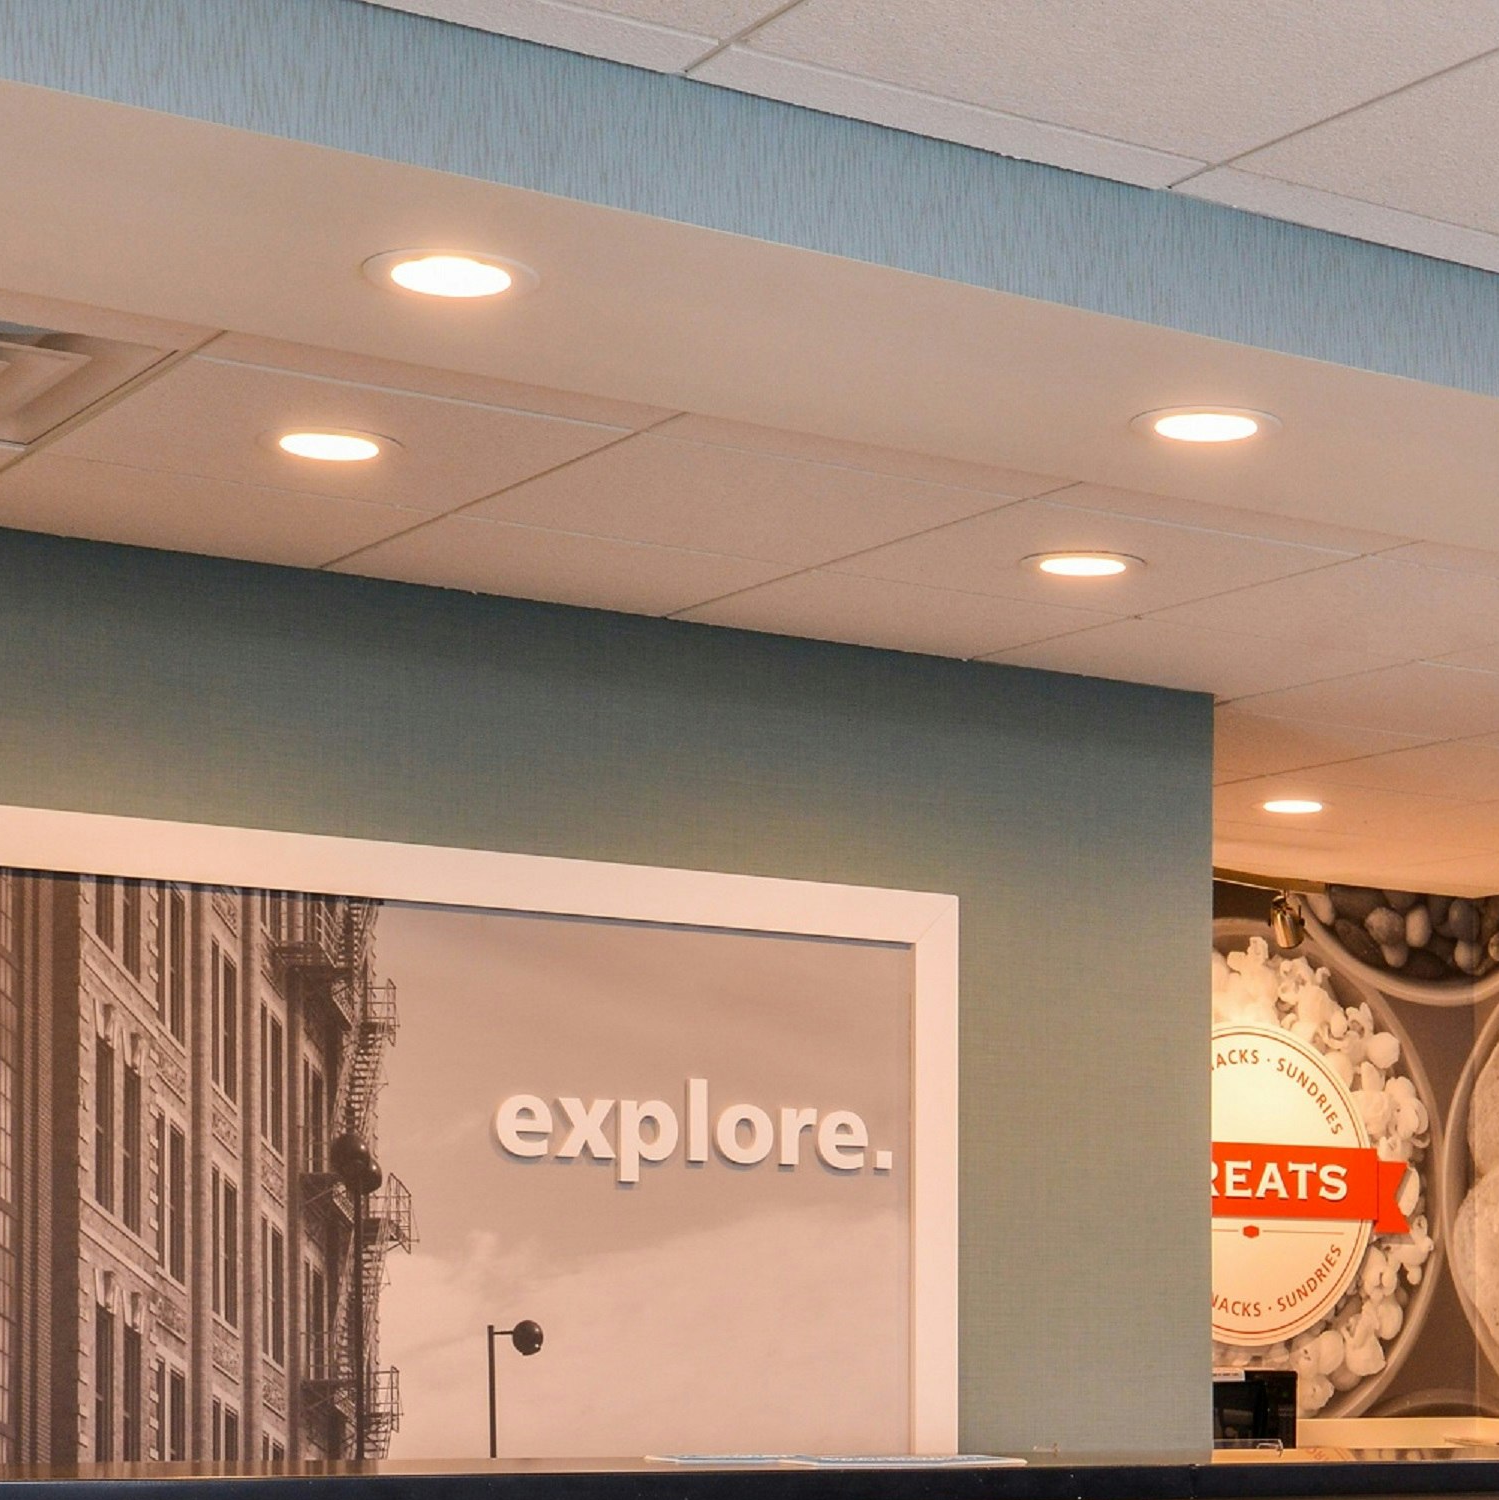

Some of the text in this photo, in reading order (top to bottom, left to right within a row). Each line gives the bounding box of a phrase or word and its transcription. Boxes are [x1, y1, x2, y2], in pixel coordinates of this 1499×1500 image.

[496, 1078, 893, 1182] explore.
[1211, 1049, 1344, 1135] ACKS SUNDRIES
[1276, 1244, 1342, 1312] SUNDRIES
